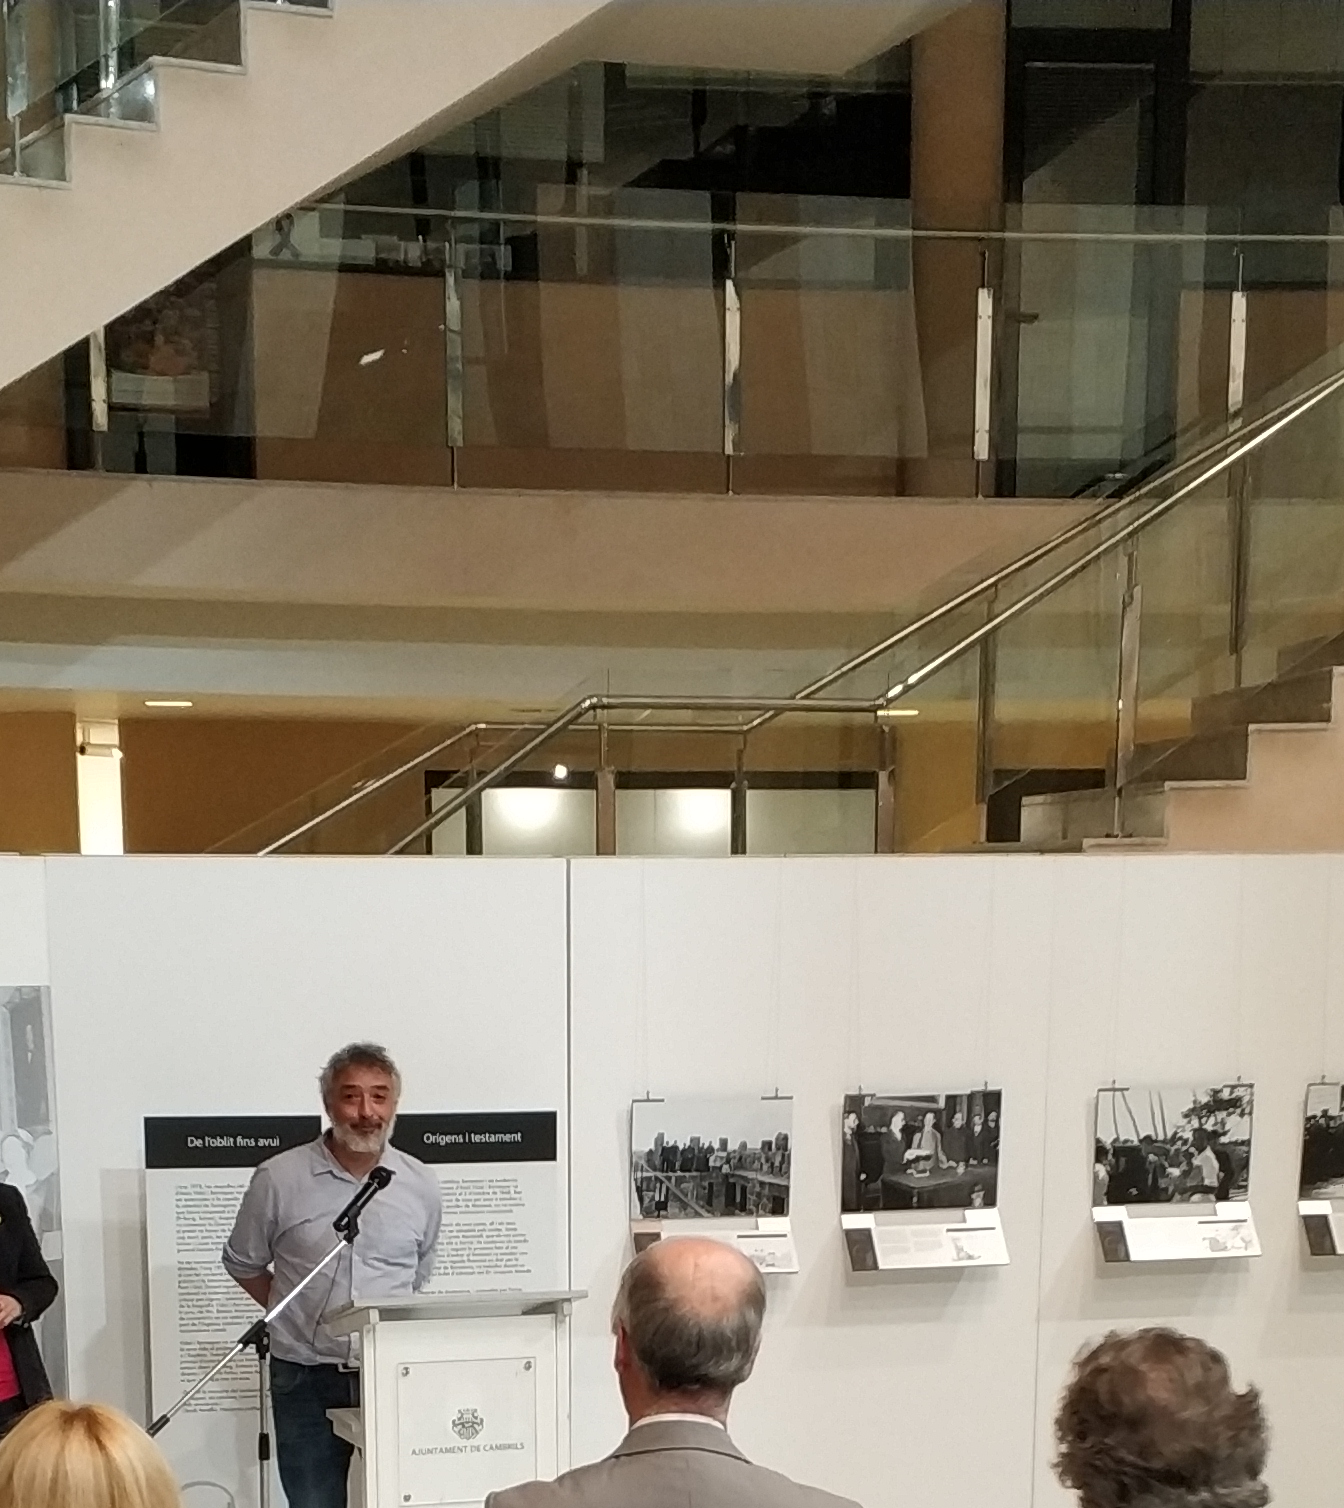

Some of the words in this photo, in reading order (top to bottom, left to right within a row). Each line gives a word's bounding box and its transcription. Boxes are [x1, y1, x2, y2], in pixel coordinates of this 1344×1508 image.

[187, 1136, 203, 1147] De
[236, 1135, 256, 1147] fins
[258, 1135, 280, 1147] avui
[471, 1131, 522, 1143] testament
[411, 1445, 468, 1456] AJUNTAMENT
[470, 1444, 481, 1453] DE
